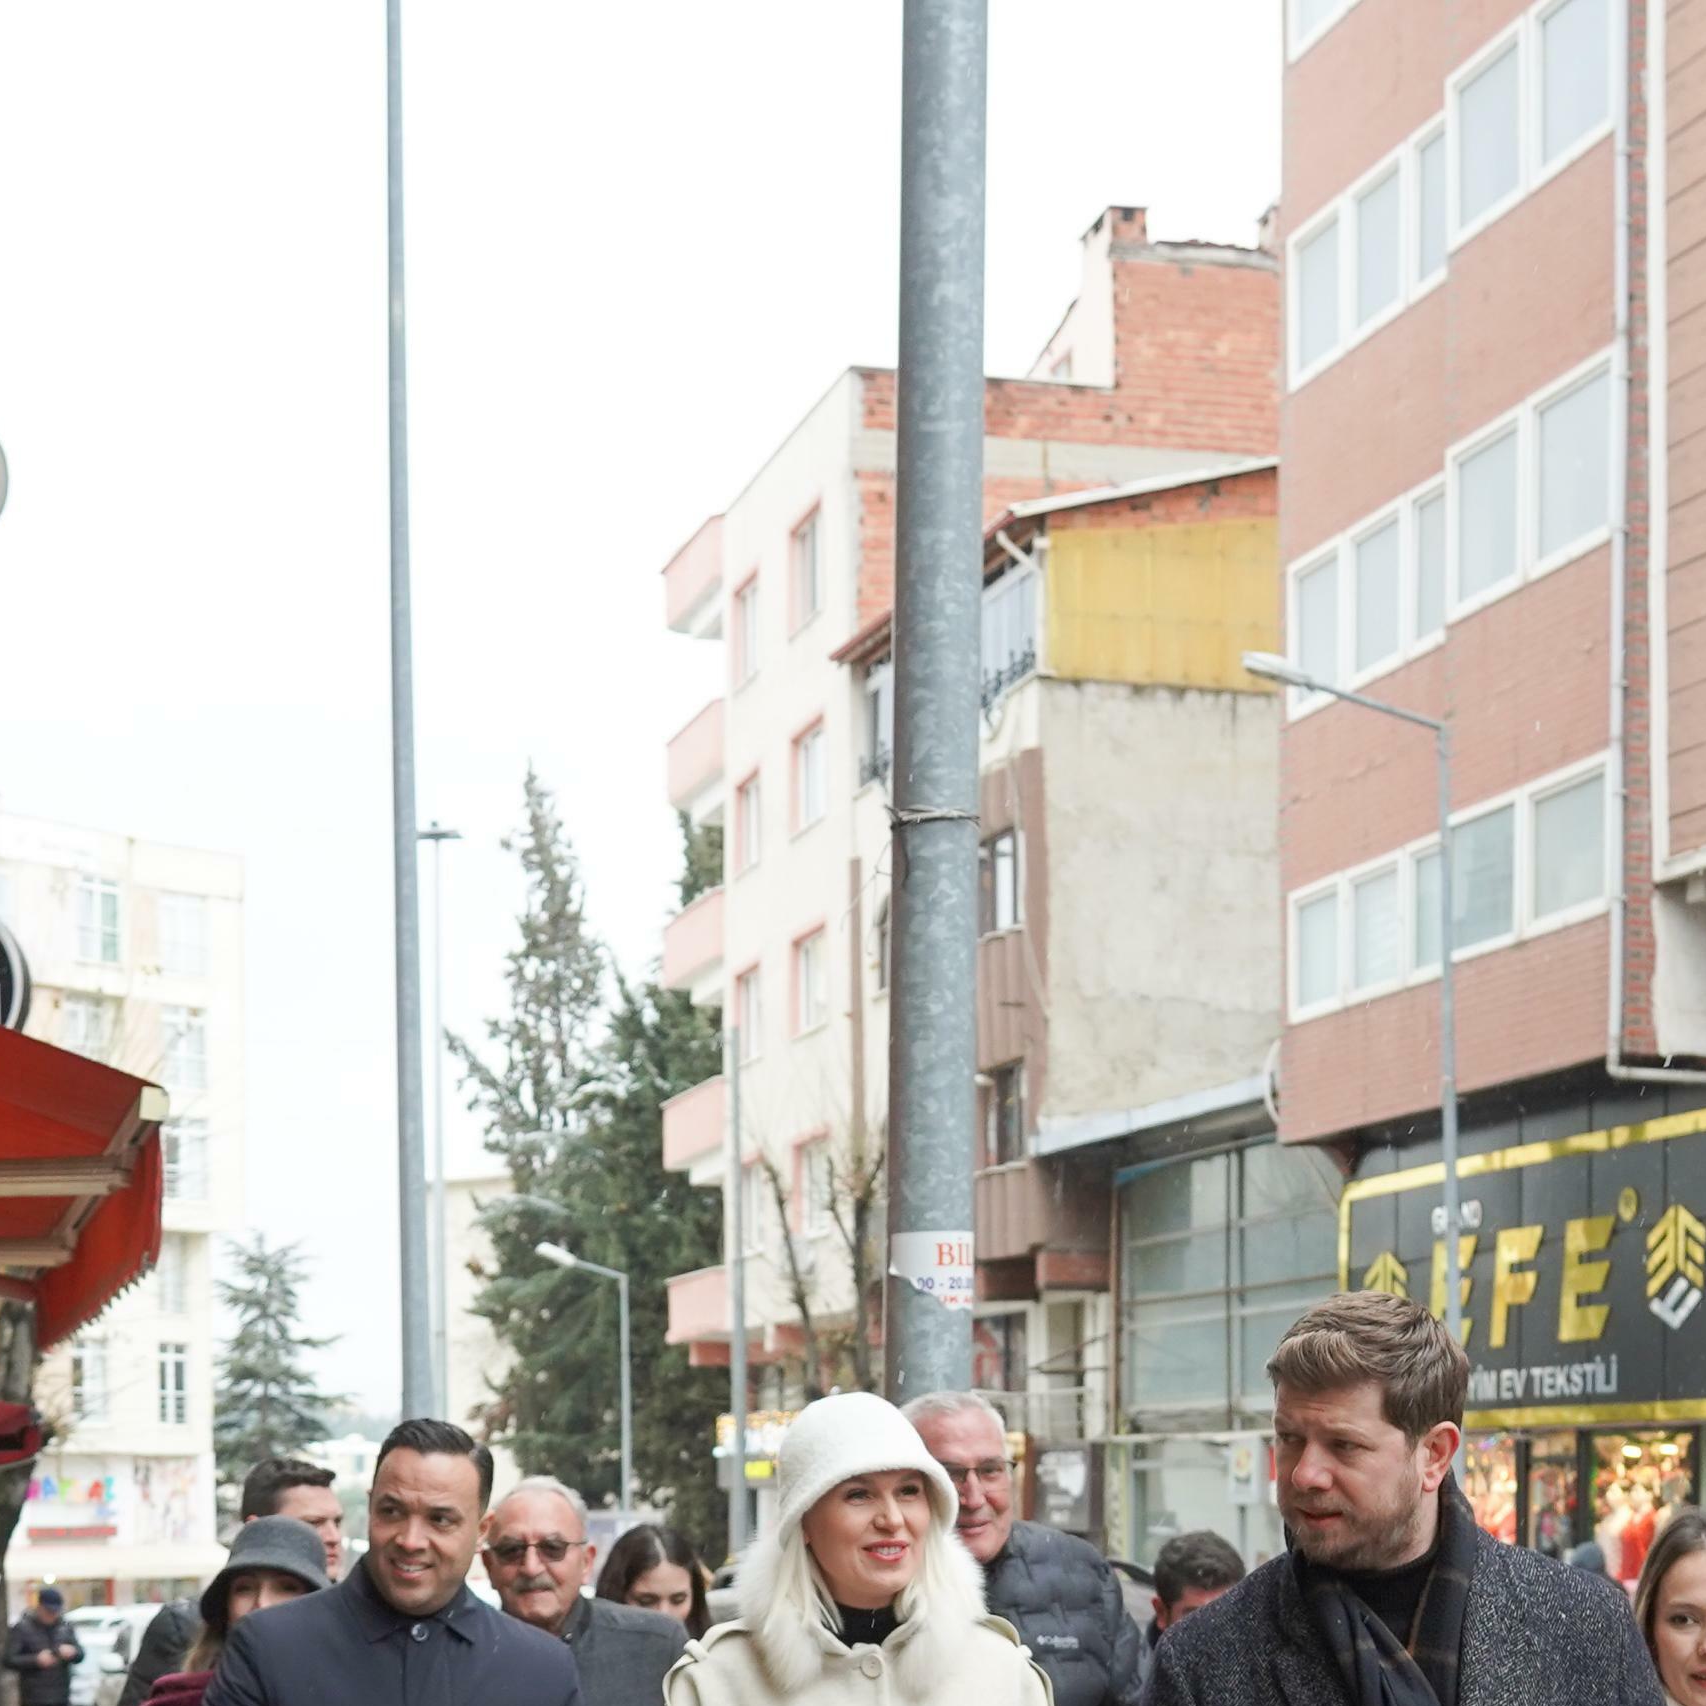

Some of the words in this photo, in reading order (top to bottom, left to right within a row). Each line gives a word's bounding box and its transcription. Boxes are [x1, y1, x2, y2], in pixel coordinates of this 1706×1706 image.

[1430, 1215, 1616, 1349] EFE
[1499, 1367, 1529, 1401] EV
[1530, 1353, 1618, 1399] TEKSTİLİ
